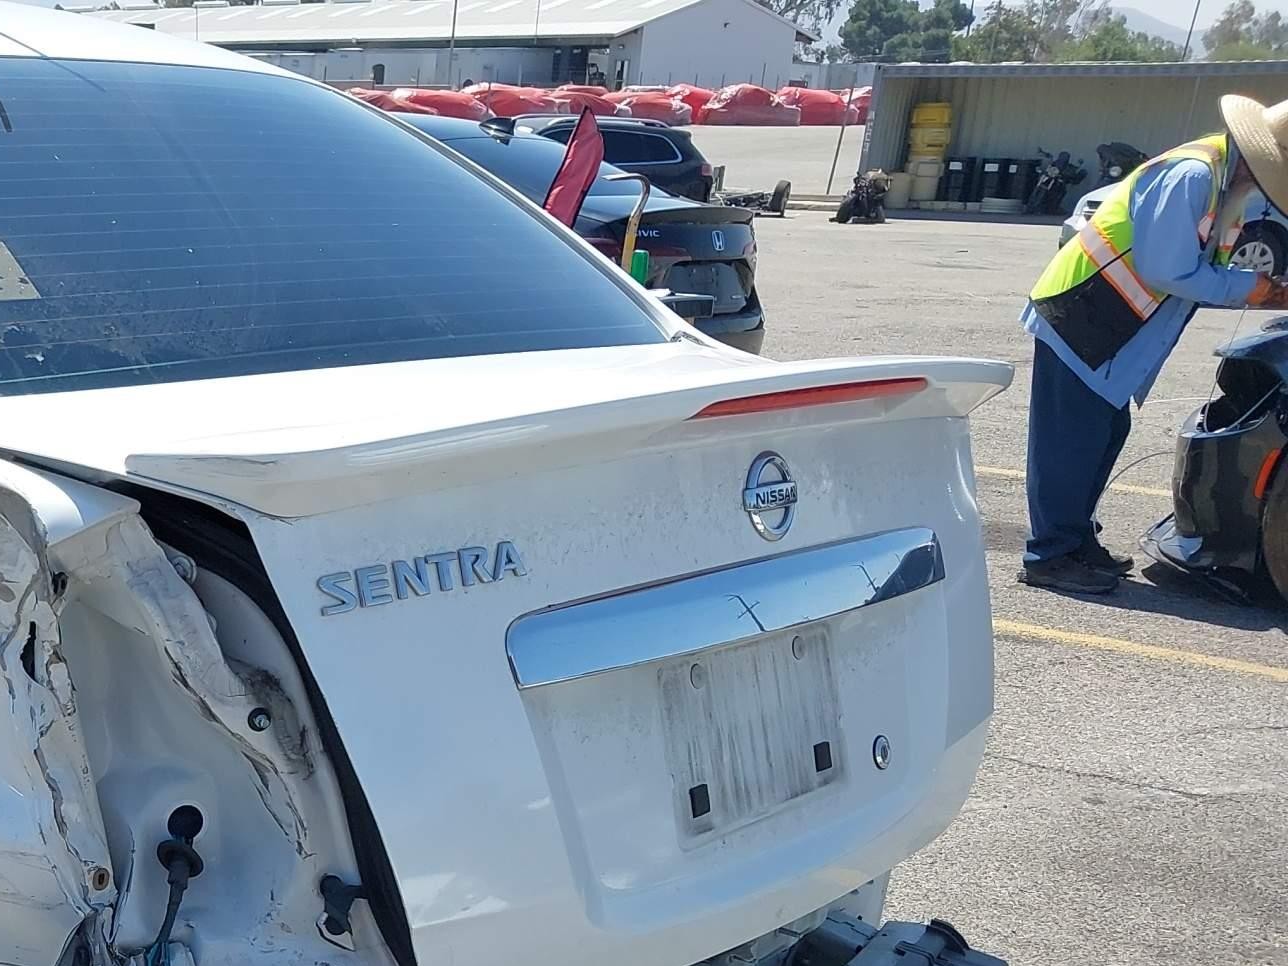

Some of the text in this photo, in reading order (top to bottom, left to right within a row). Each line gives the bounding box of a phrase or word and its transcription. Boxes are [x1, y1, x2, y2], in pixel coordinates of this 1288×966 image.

[637, 229, 661, 237] IVIC
[755, 485, 796, 505] NISSAN
[317, 540, 527, 616] SENTRA
